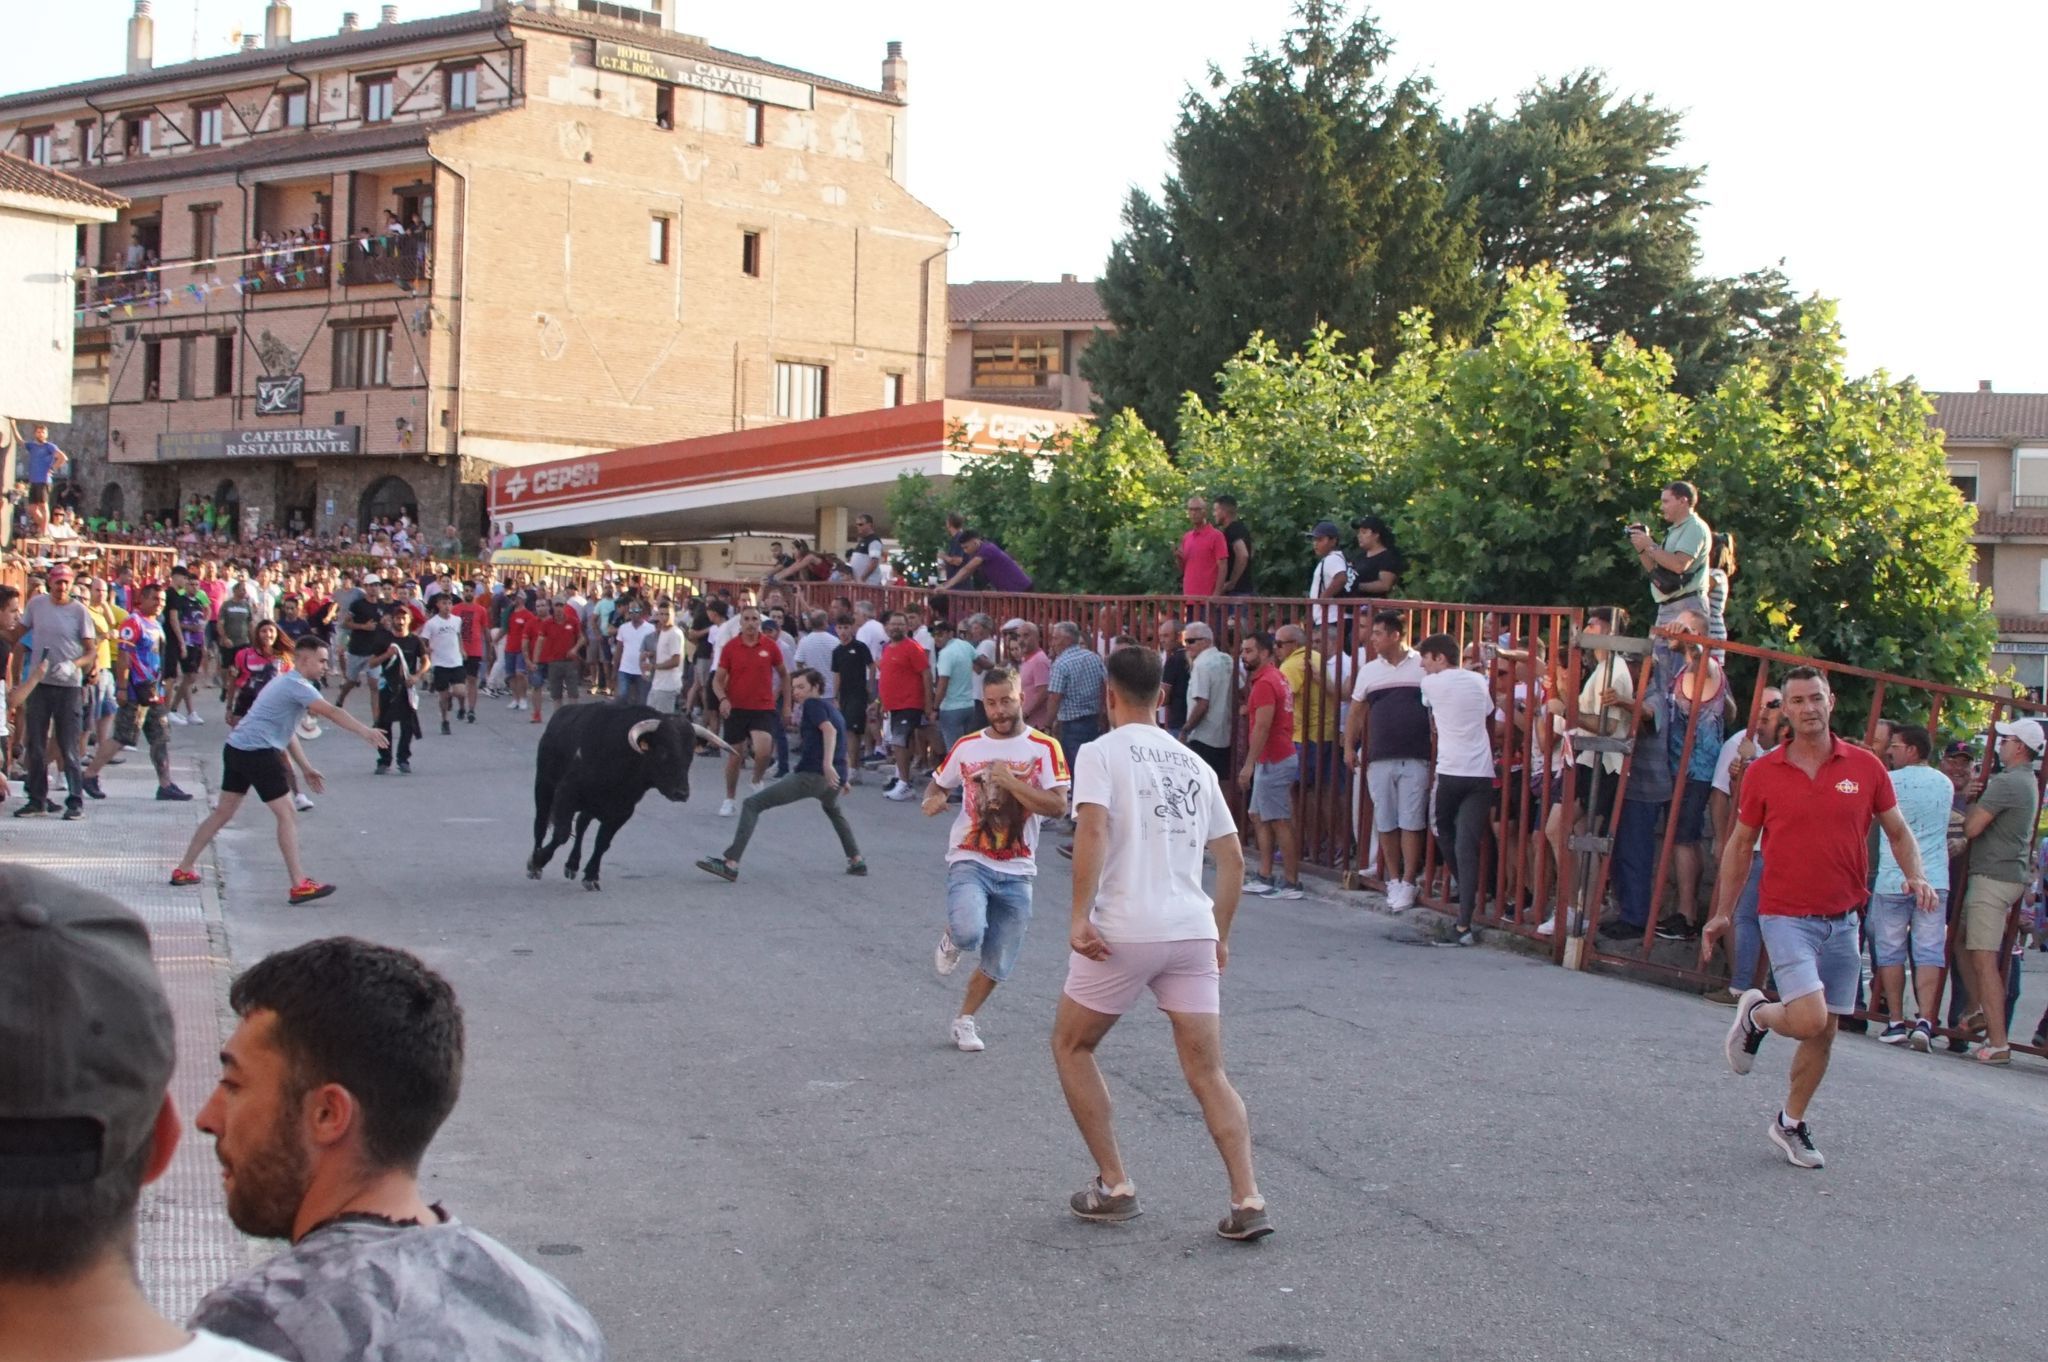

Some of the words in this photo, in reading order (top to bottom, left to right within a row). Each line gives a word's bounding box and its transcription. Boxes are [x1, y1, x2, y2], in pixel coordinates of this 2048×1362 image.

[617, 46, 653, 63] HOTEL
[242, 429, 335, 443] CAFETERIA
[226, 441, 350, 456] RESTAURANTE
[532, 462, 599, 494] CEPSA
[1129, 744, 1200, 775] SCALPERS
